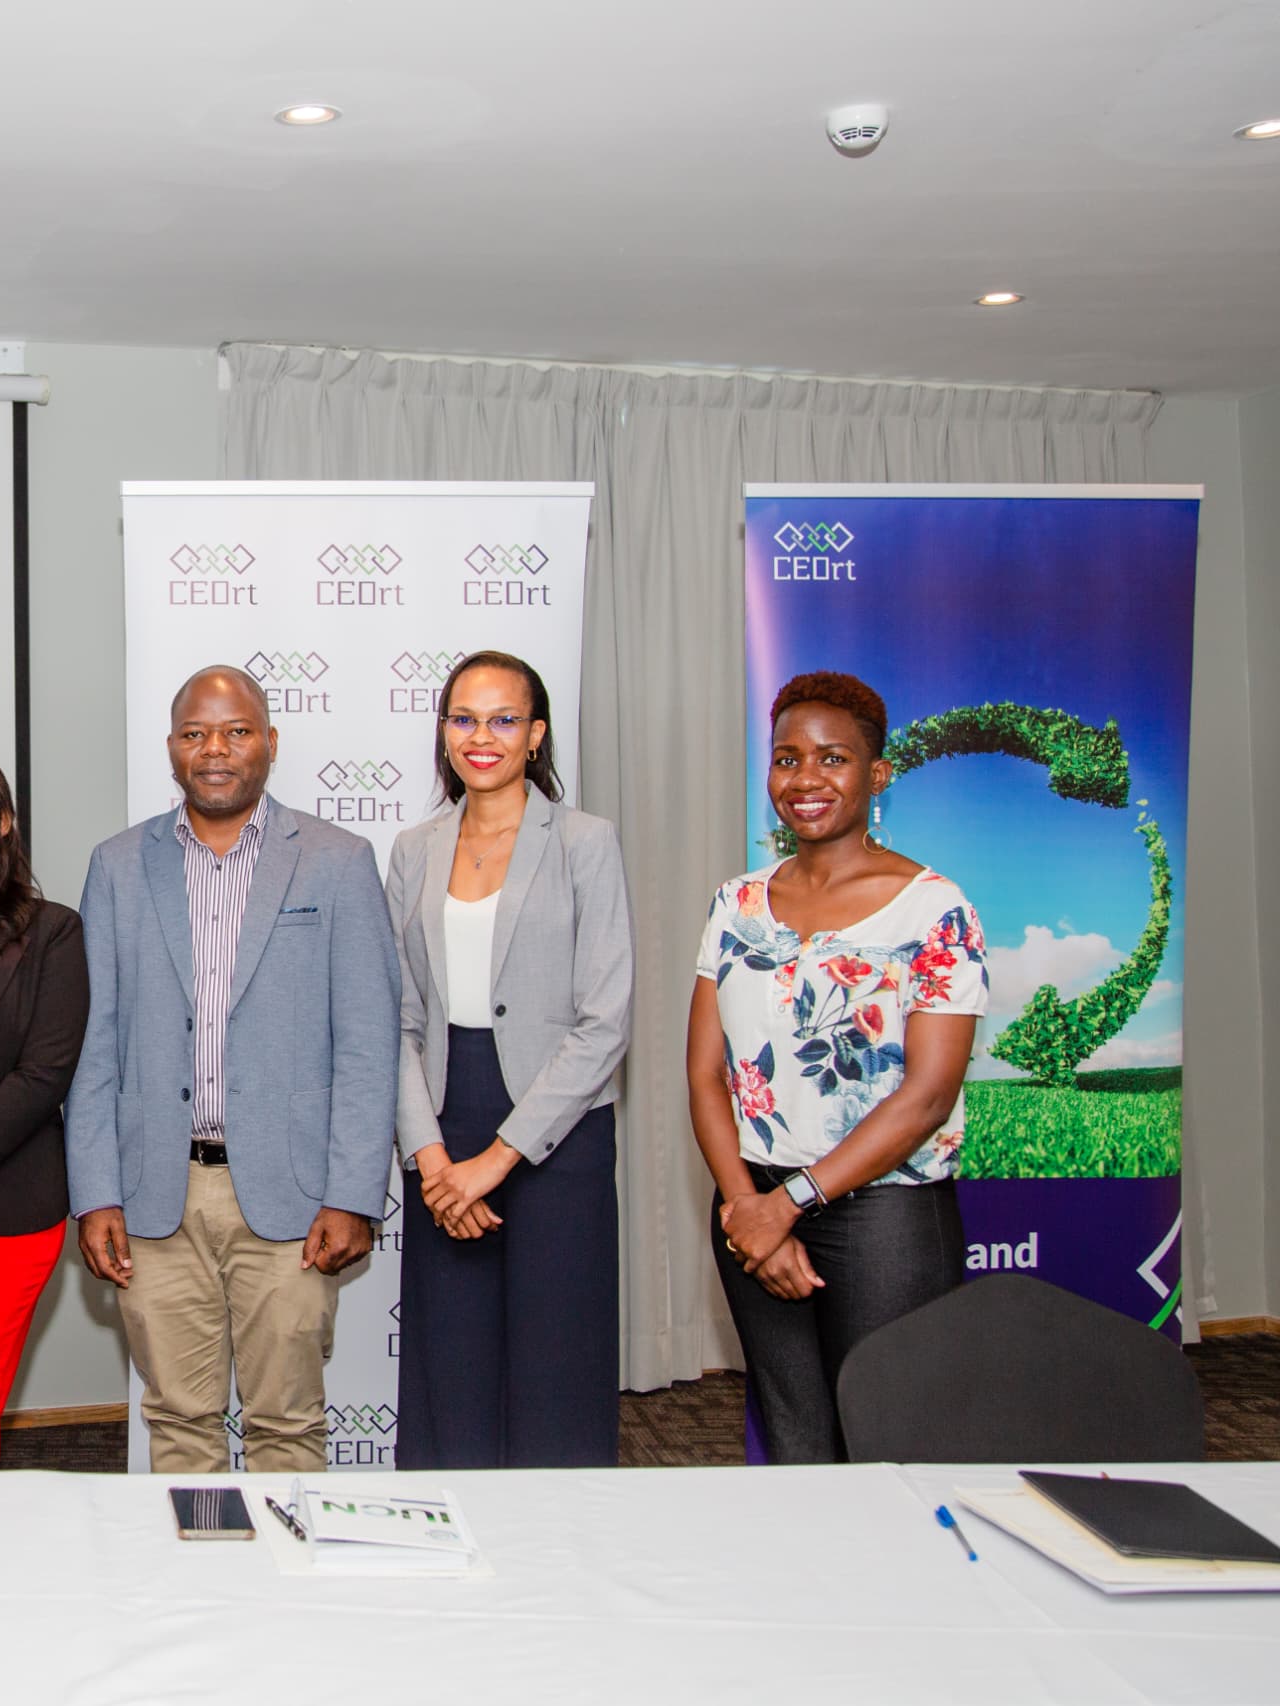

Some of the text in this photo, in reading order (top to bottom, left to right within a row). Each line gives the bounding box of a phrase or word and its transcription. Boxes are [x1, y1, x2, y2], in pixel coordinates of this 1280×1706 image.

[773, 556, 856, 581] CEOrt
[168, 581, 259, 606] CEOrt
[316, 581, 405, 606] CEOrt
[463, 581, 552, 606] CEOrt
[264, 687, 332, 713] EOrt
[316, 797, 405, 822] CEOrt
[966, 1231, 1039, 1270] and
[321, 1499, 452, 1524] IUCN
